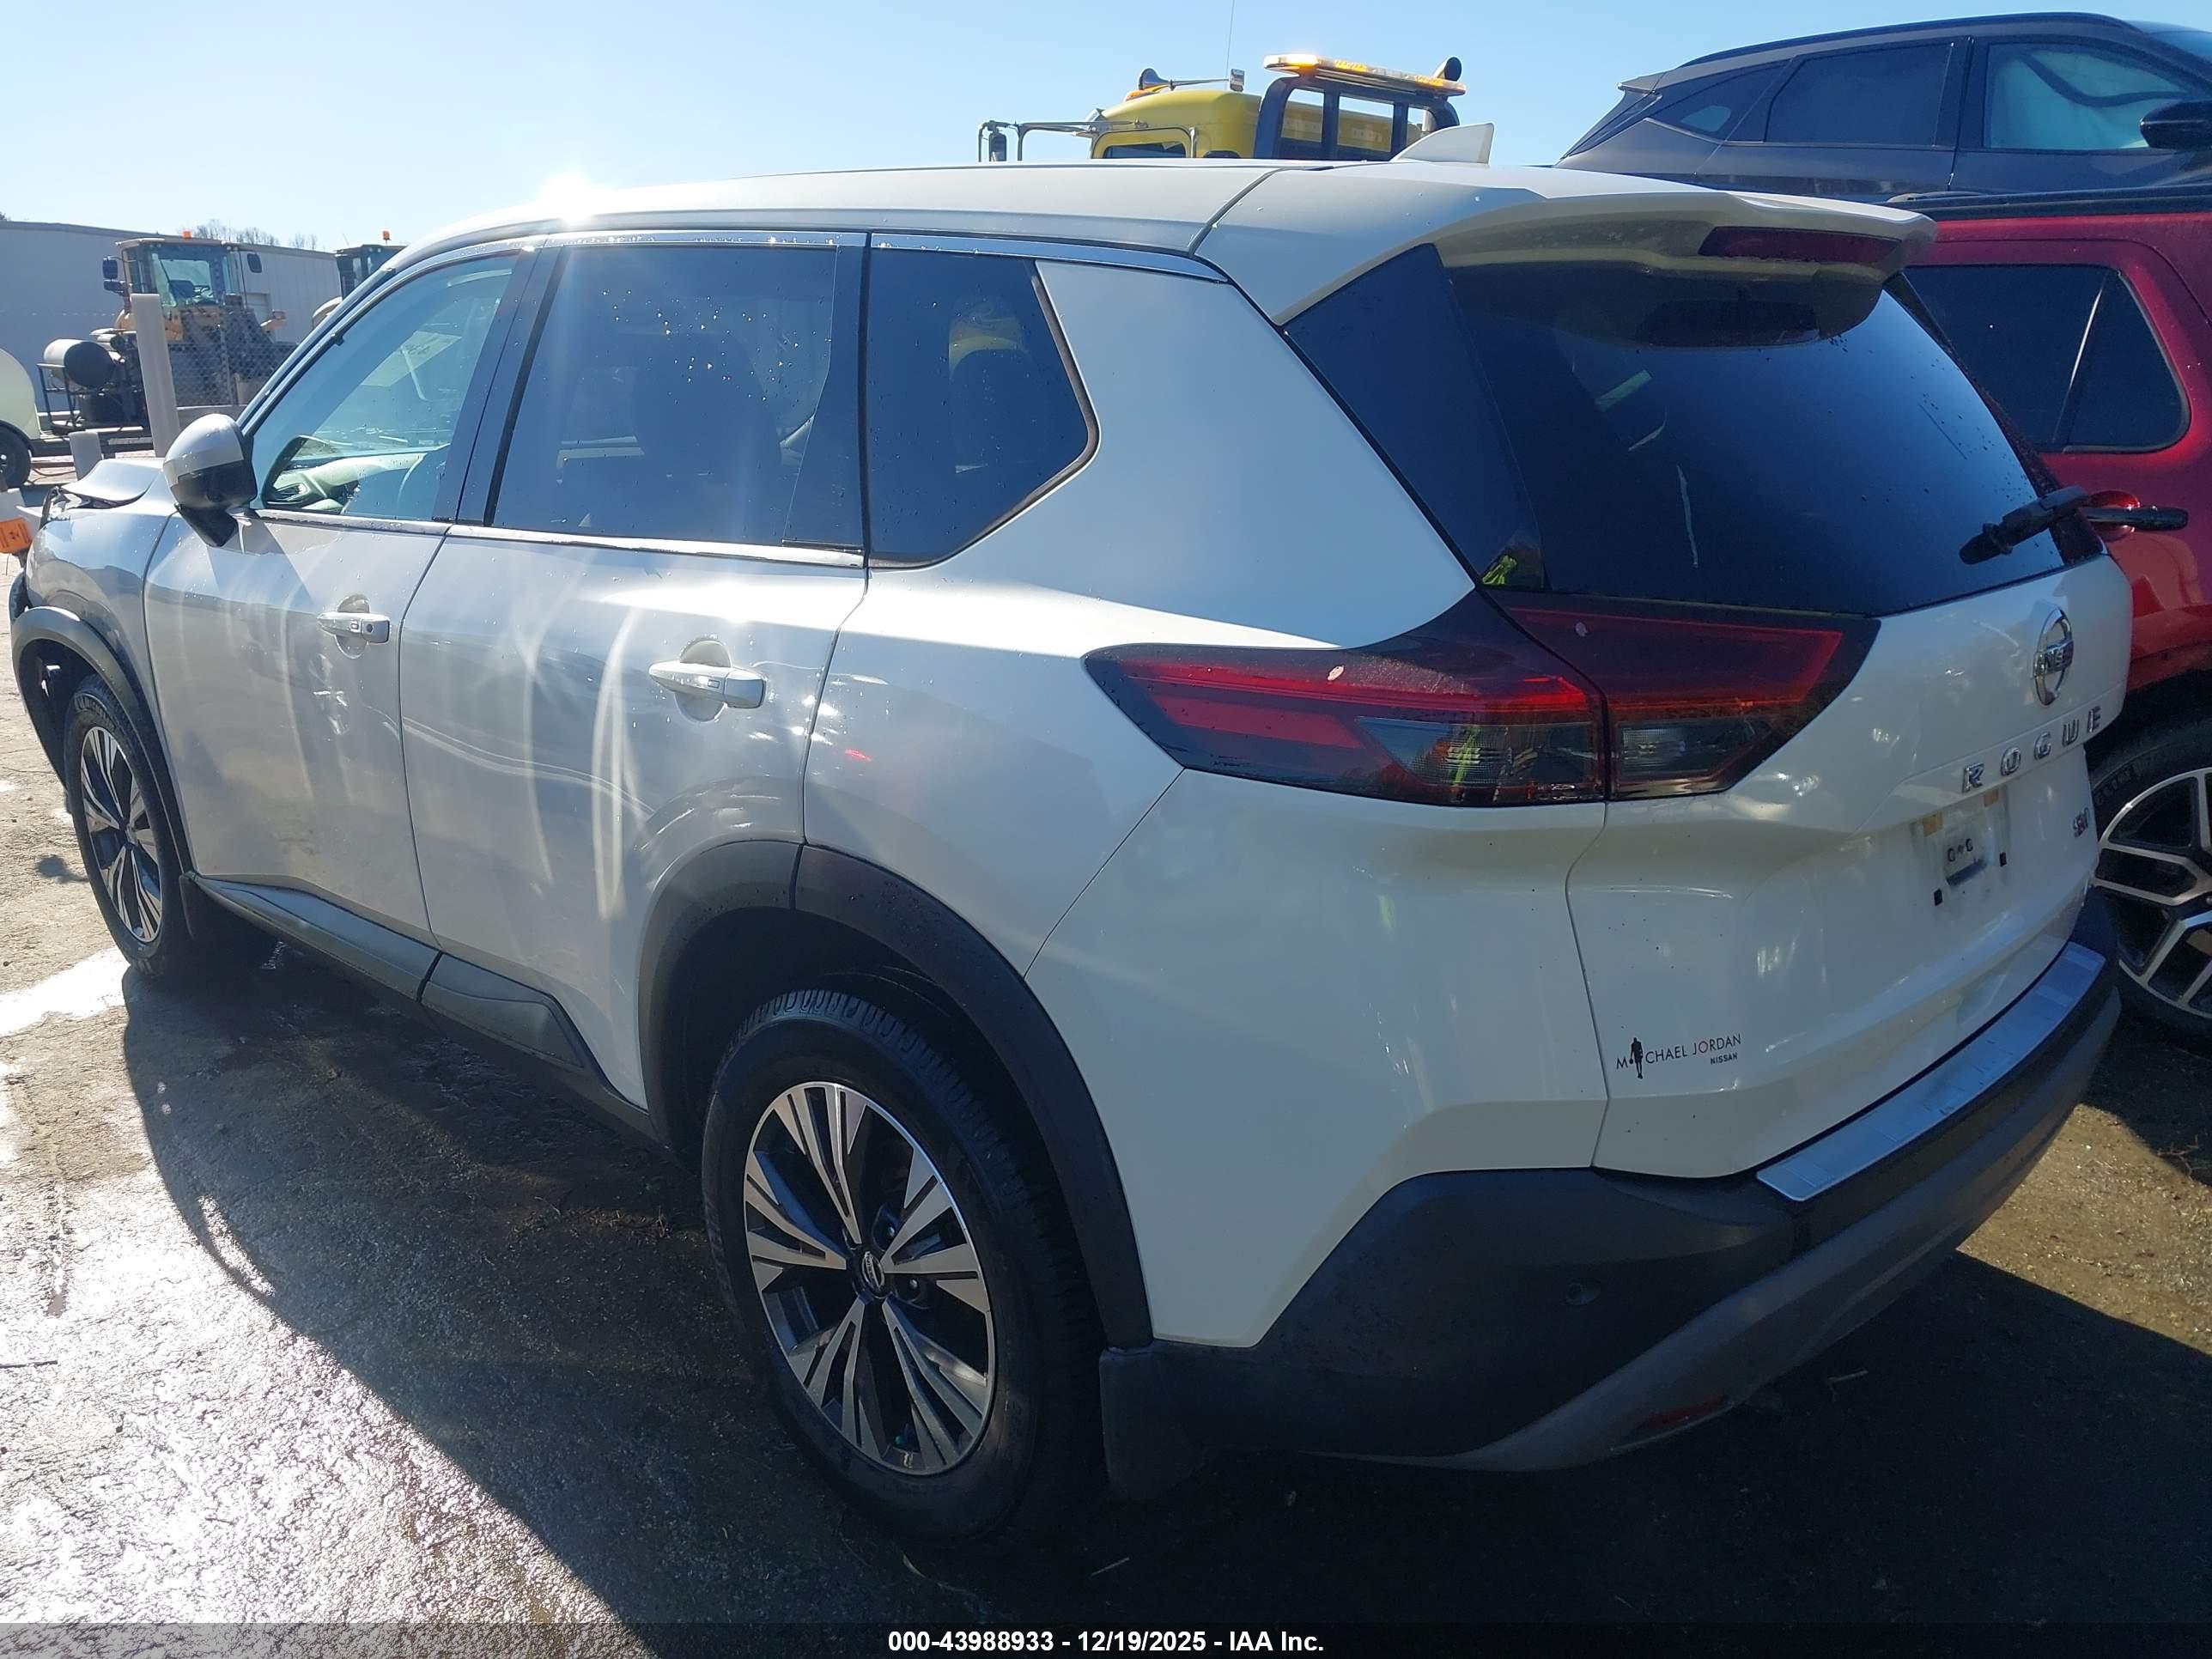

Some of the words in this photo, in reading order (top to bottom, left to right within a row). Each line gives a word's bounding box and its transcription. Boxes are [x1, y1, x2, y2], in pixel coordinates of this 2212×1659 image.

[1962, 706, 2101, 794] ROGUE
[1692, 1033, 1741, 1055] JORDAN
[1711, 1052, 1738, 1065] NISSAN
